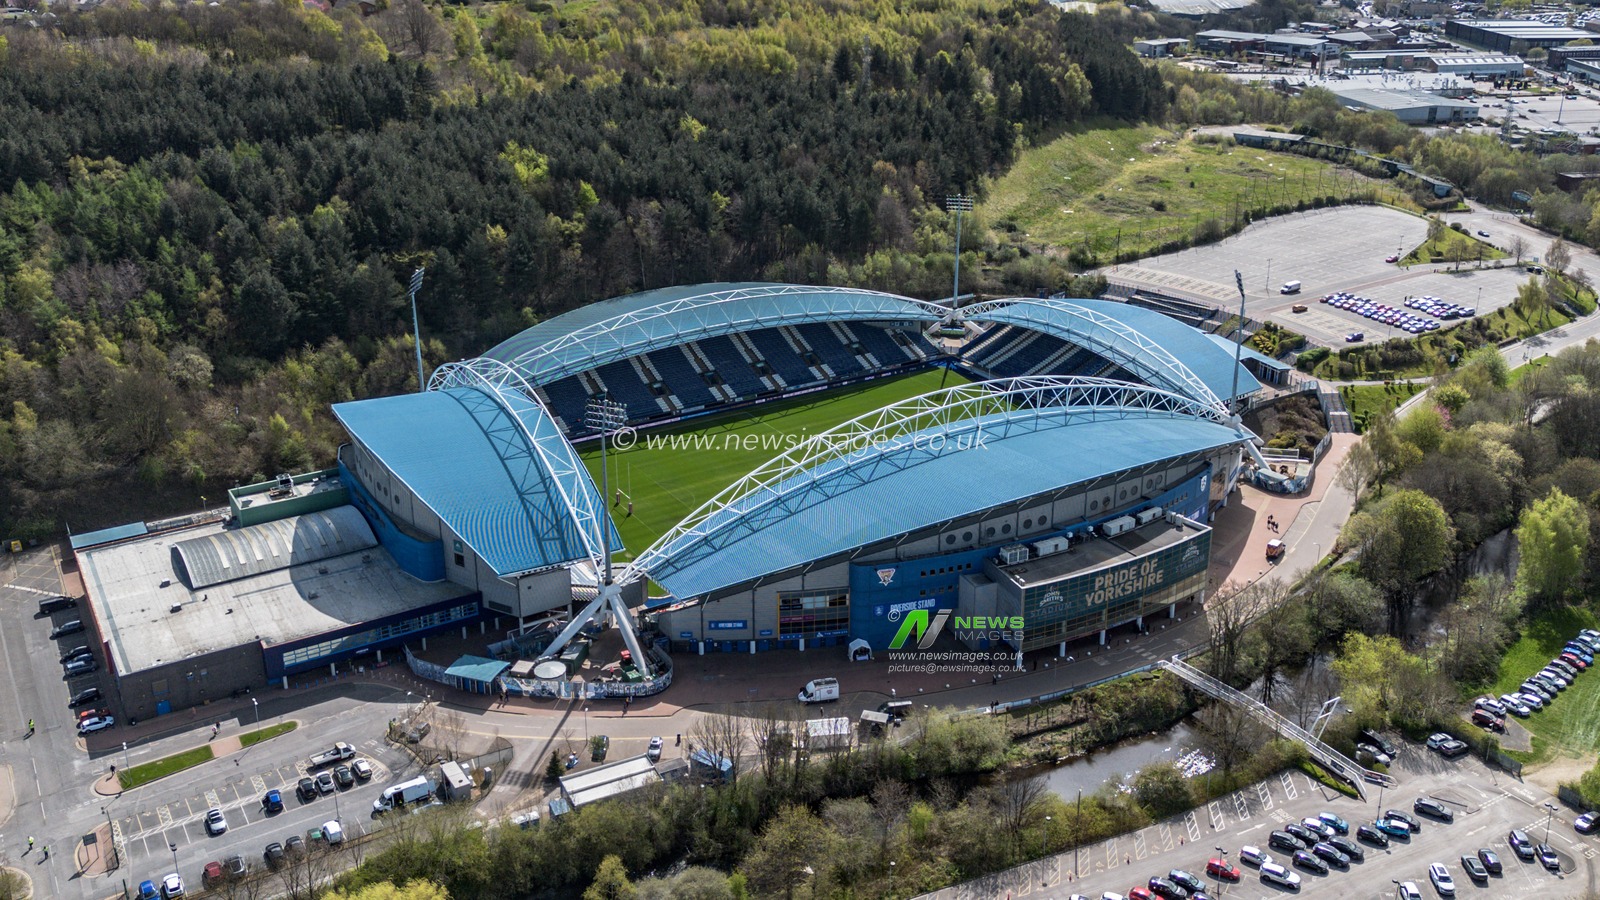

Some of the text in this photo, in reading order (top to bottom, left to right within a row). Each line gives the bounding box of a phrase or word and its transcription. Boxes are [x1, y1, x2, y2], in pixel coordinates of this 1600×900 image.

[1085, 569, 1164, 607] YORKSHIRE
[1095, 558, 1159, 591] PRIDE OF
[890, 598, 936, 612] RIVERSIDE STAND
